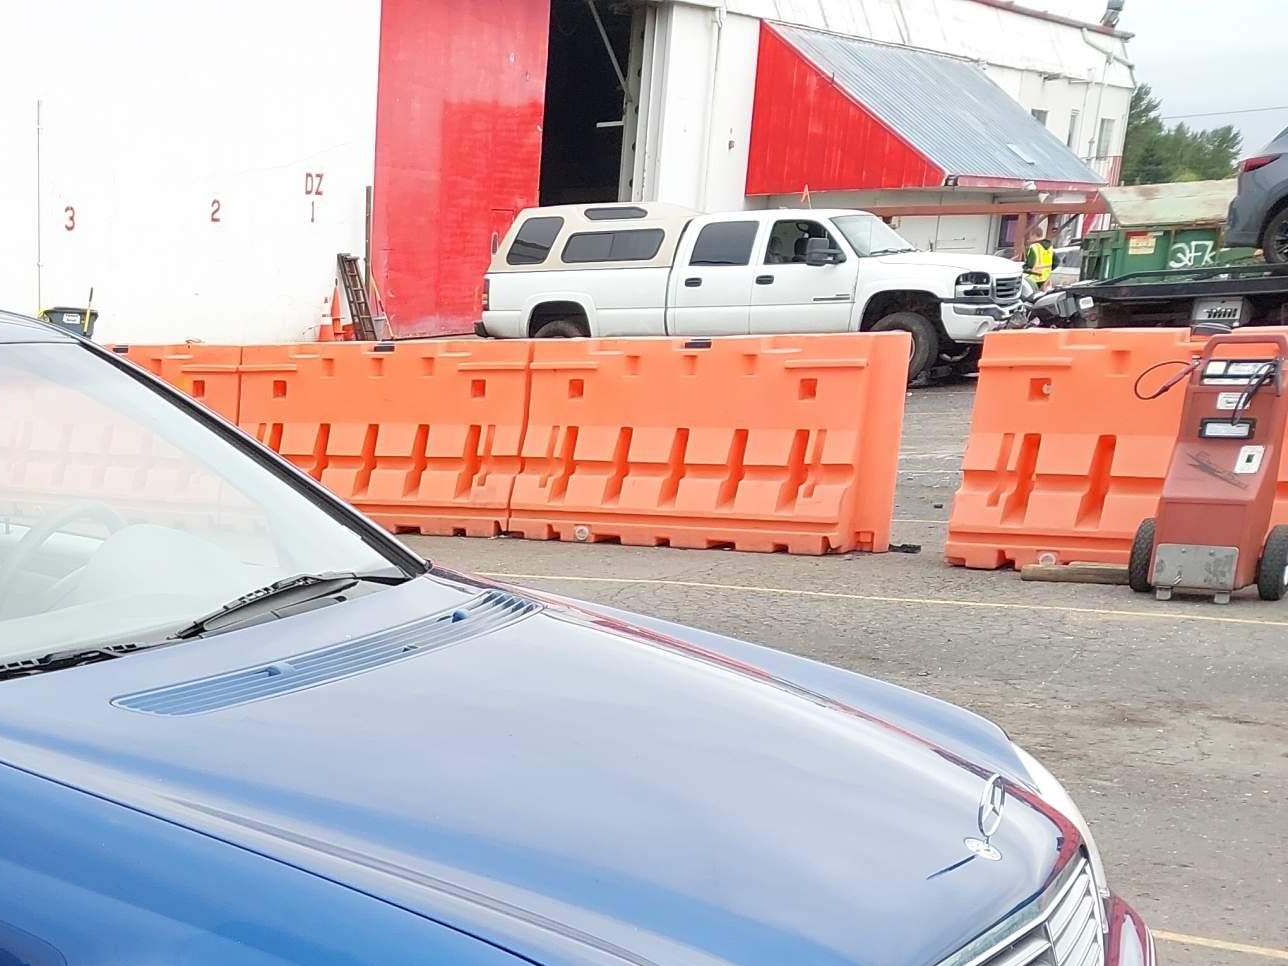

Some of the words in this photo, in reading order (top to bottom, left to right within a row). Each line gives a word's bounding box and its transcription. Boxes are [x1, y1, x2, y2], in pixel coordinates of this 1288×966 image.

[304, 171, 325, 197] DZ
[64, 205, 76, 232] 3
[210, 198, 221, 224] 2
